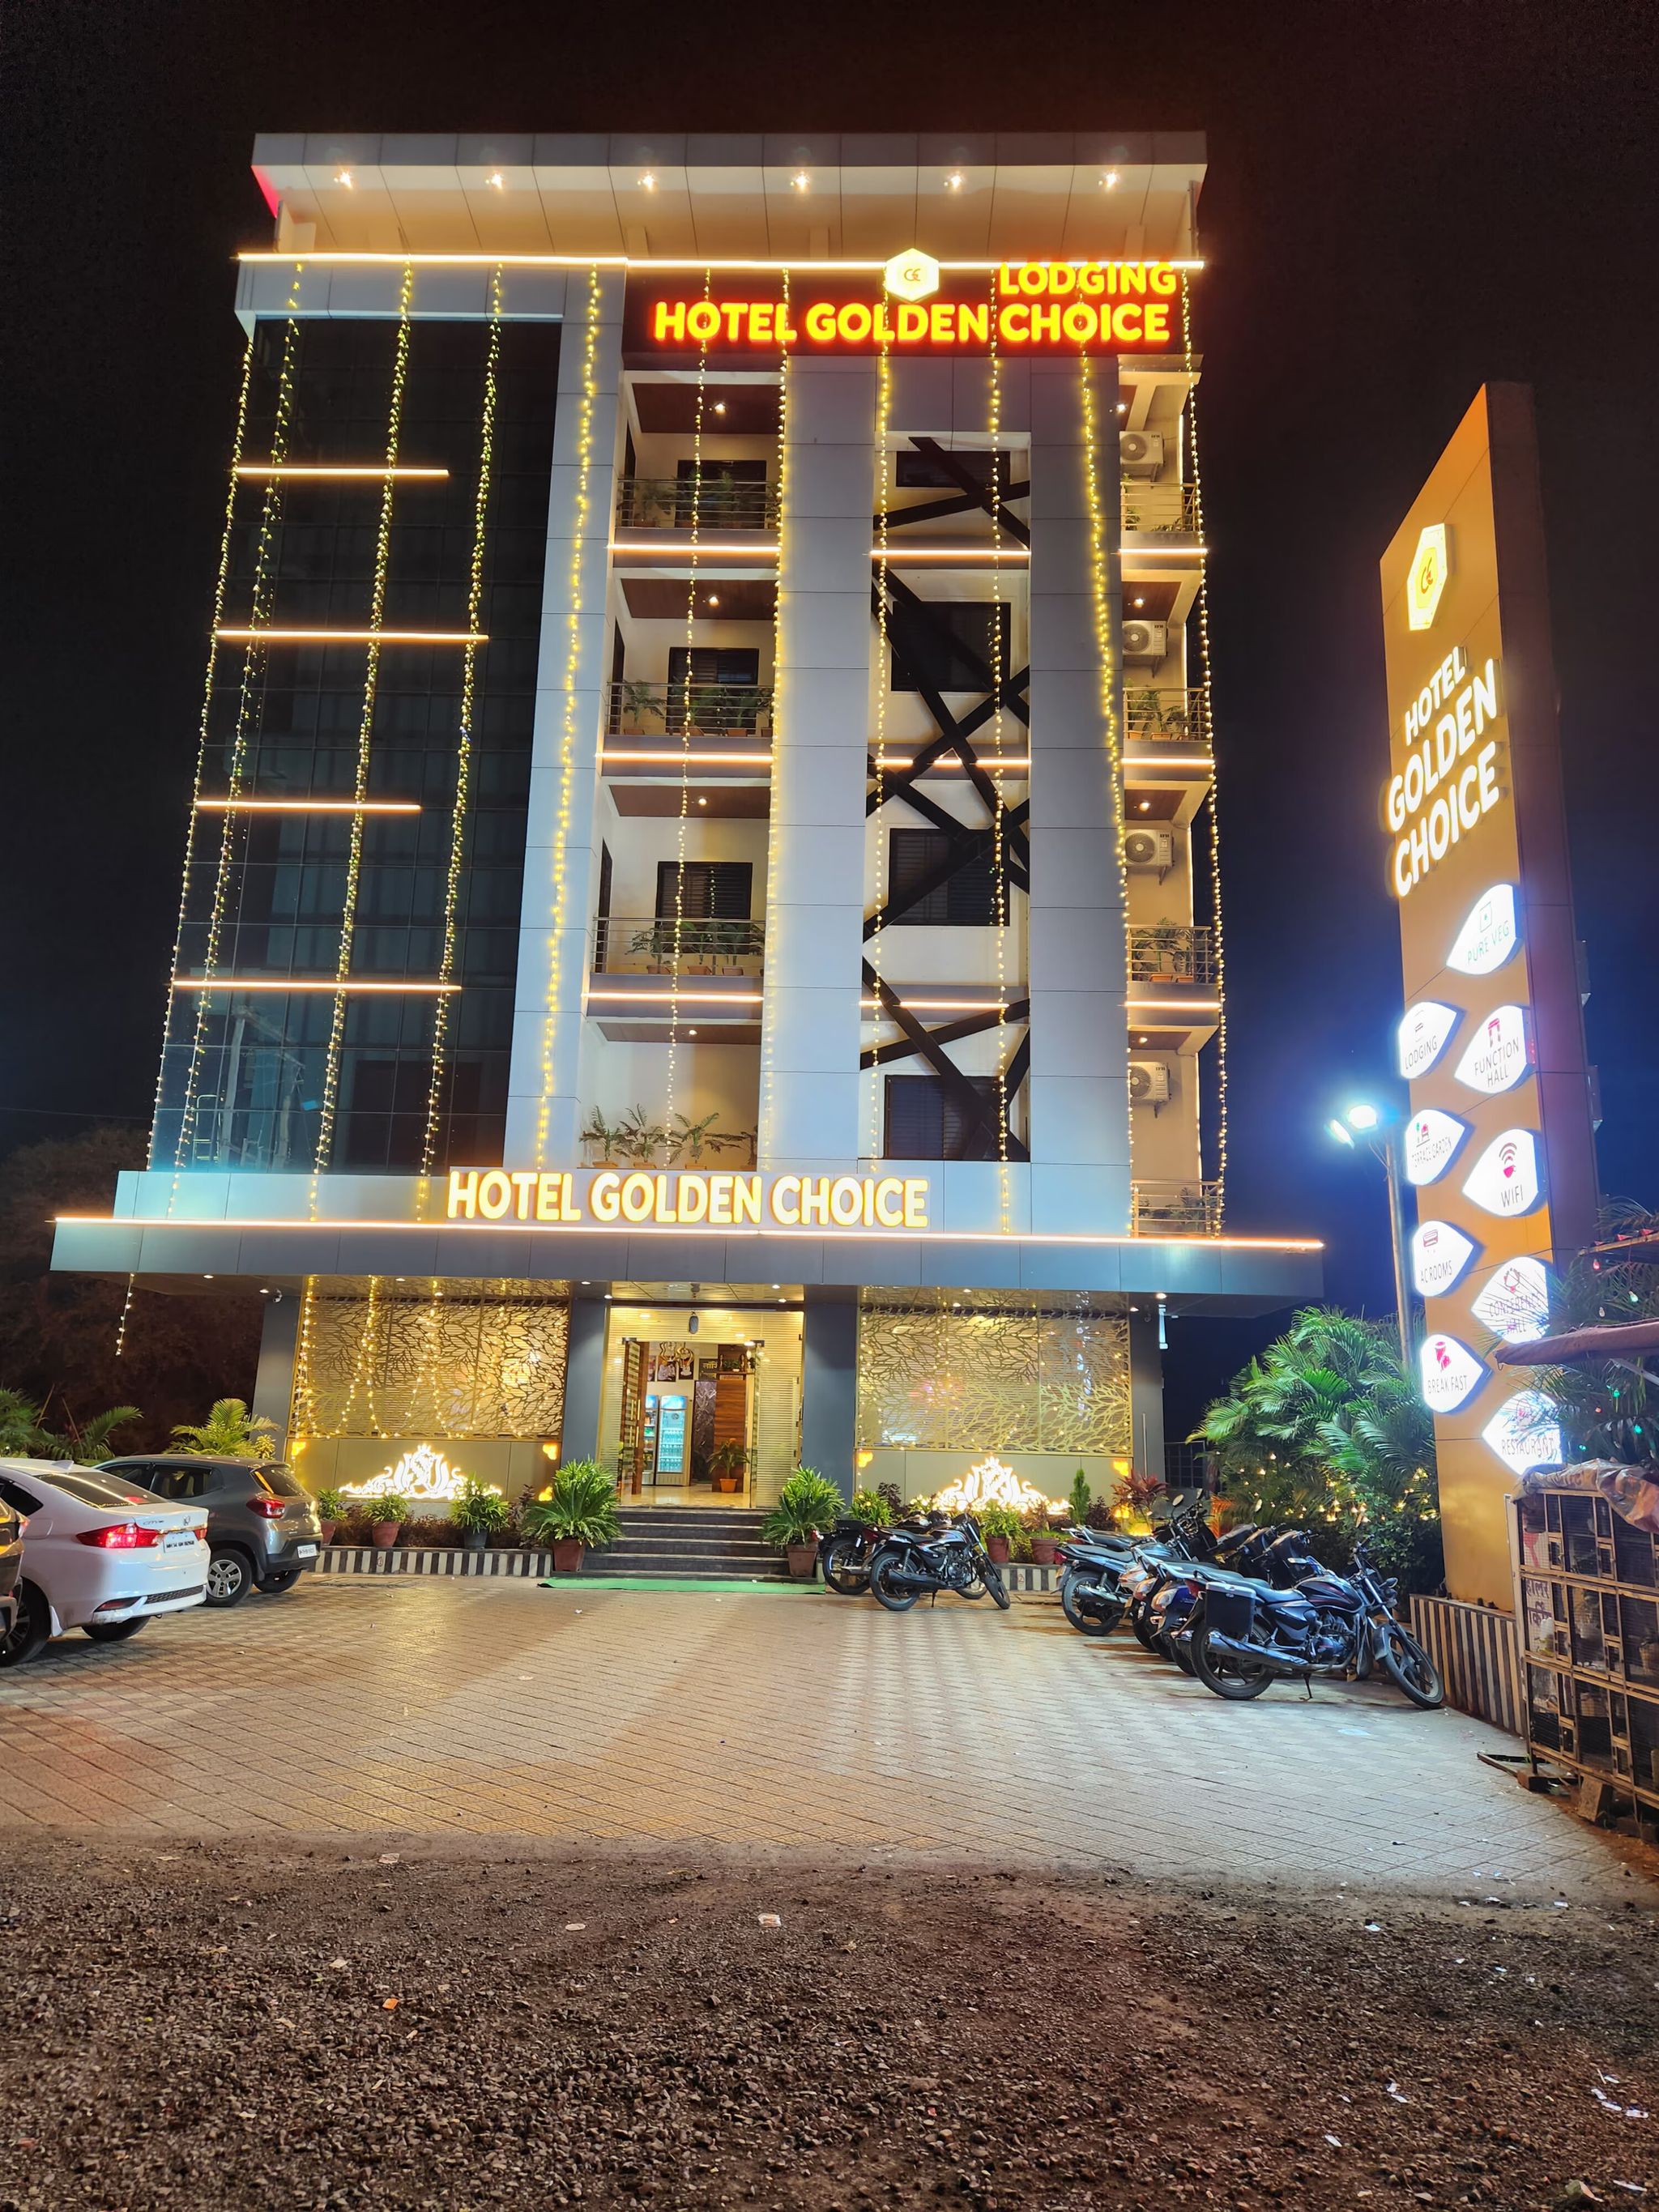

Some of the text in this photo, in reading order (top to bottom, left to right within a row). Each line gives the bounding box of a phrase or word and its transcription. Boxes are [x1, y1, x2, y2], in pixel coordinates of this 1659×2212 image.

[1000, 261, 1177, 296] LODGING
[654, 301, 1170, 343] HOTEL GOLDEN CHOICE
[1405, 646, 1467, 747] HOTEL
[1388, 658, 1497, 833] GOLDEN
[1395, 741, 1501, 897] CHOICE
[1467, 920, 1509, 965] PURE VEG
[1405, 1035, 1438, 1070] LODGING
[1473, 1037, 1520, 1076] FUNCTION
[1487, 1068, 1509, 1088] HALL
[446, 1169, 928, 1229] HOTEL GOLDEN CHOICE
[1500, 1184, 1524, 1208] WIFI
[1427, 1375, 1468, 1395] BREAK FAST
[1501, 1438, 1555, 1457] RESTAURANT
